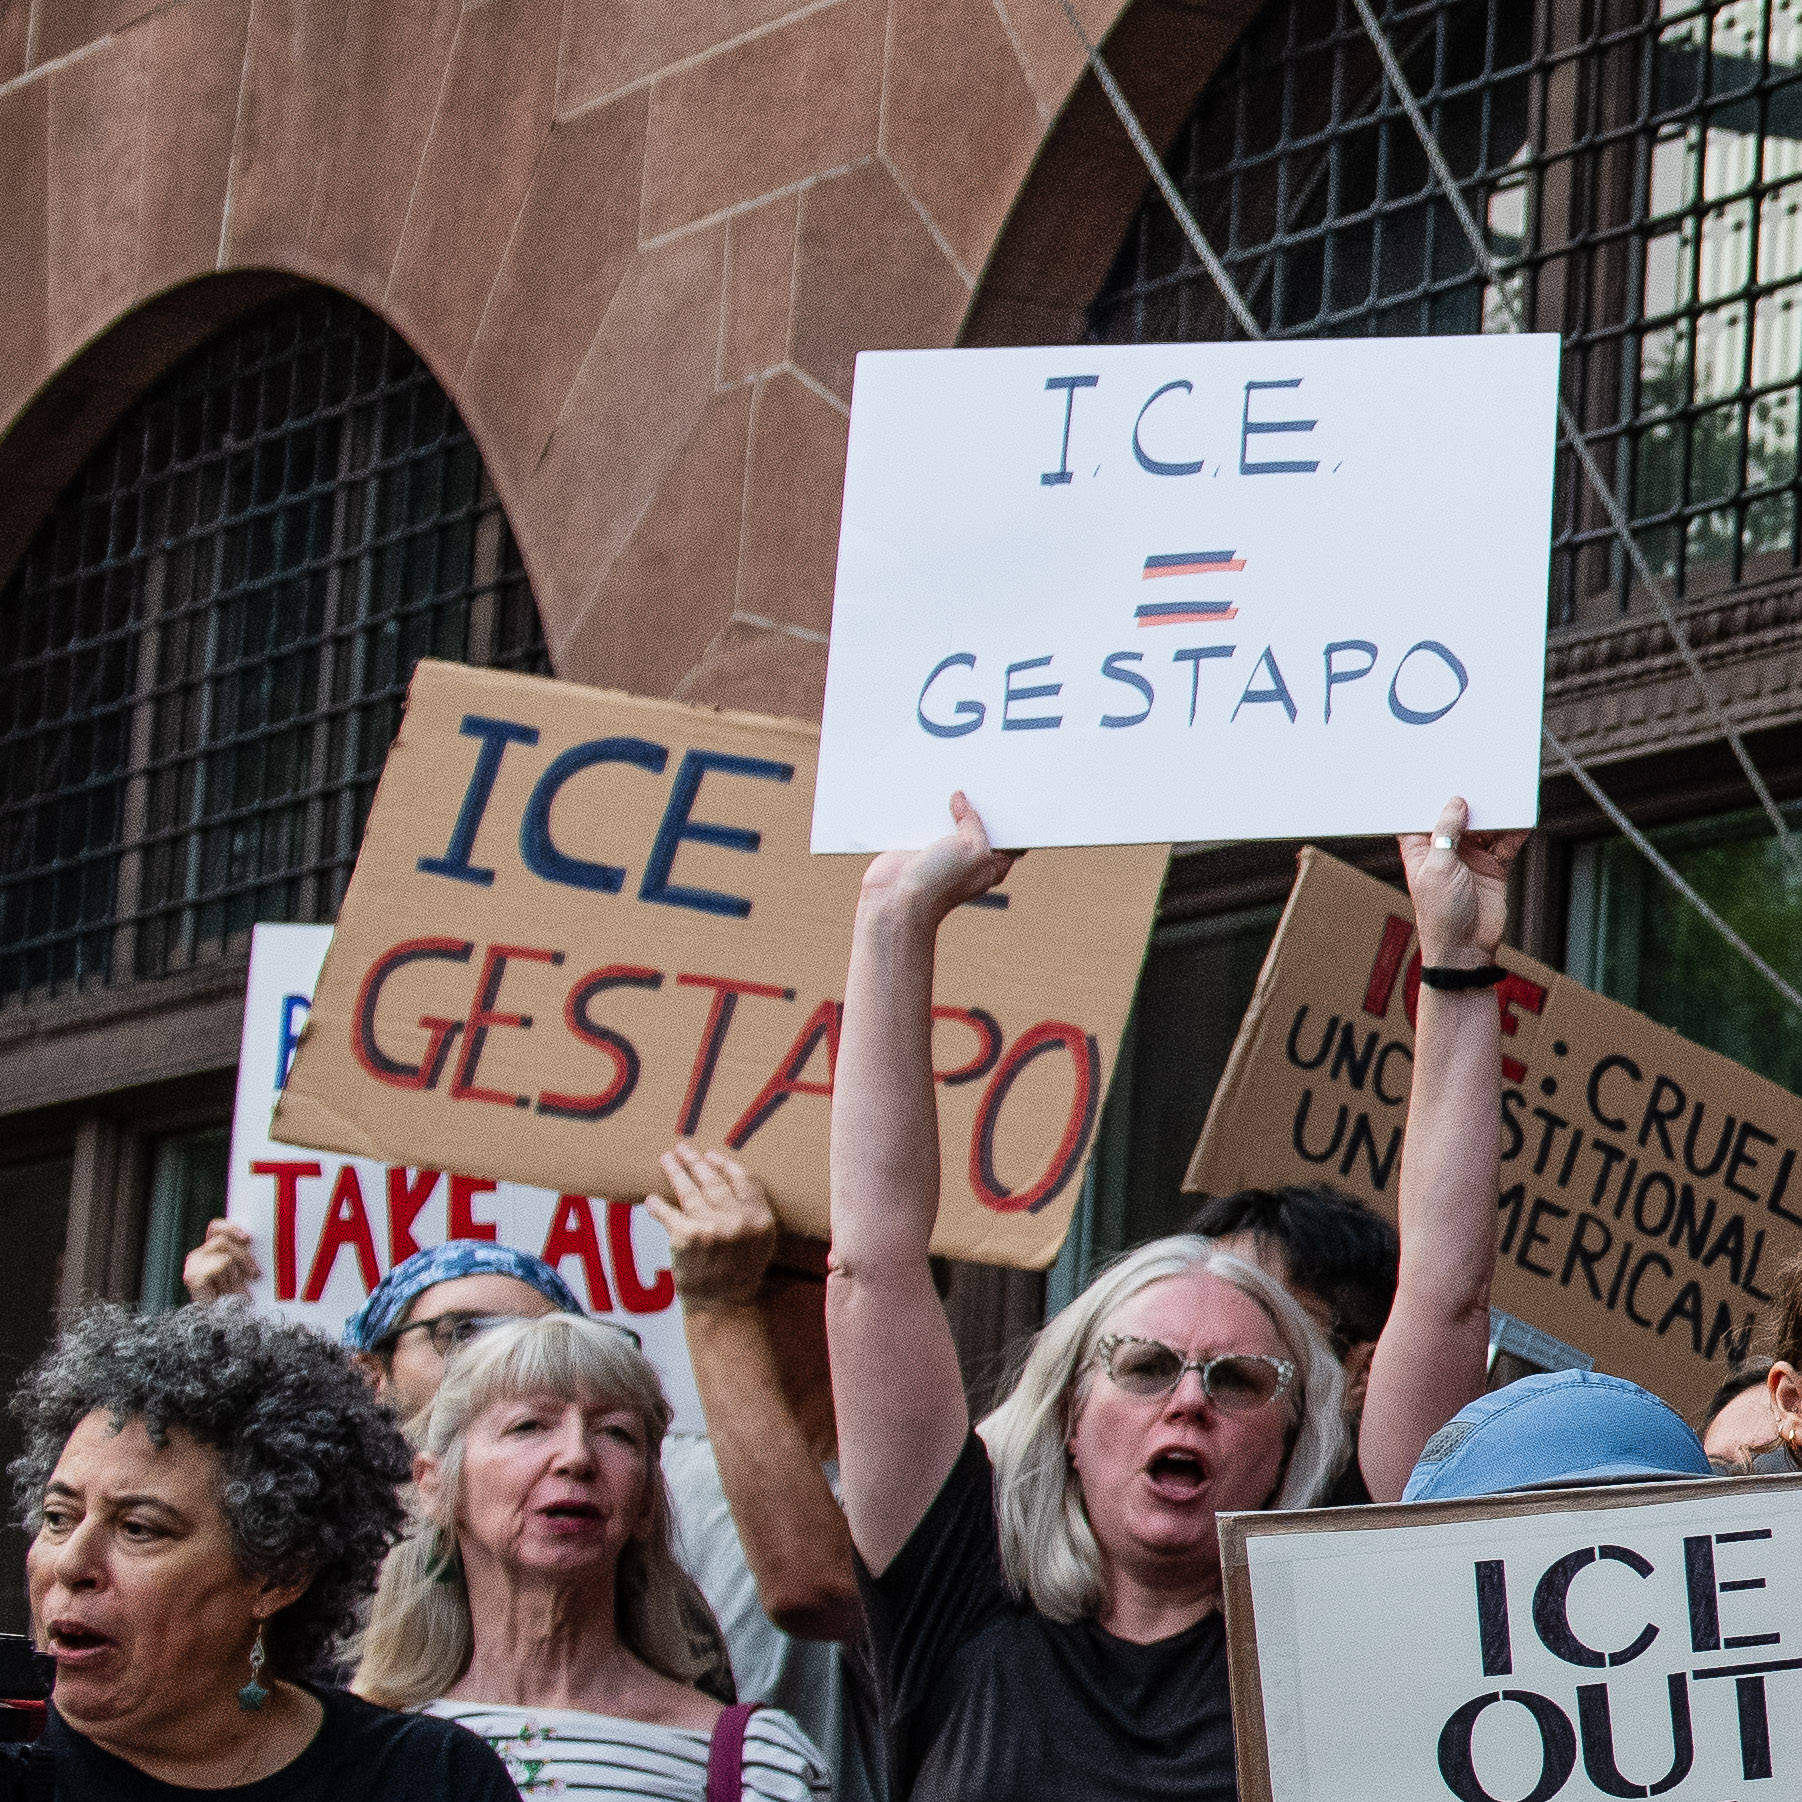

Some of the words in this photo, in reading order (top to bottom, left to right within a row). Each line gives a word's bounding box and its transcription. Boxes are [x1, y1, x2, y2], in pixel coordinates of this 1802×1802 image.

[1039, 374, 1343, 487] I.C.E.
[916, 638, 1470, 740] GESTAPO
[415, 713, 796, 919] ICE
[347, 935, 1105, 1214] GESTAPO
[1362, 914, 1569, 1097] IE:
[1286, 1004, 1774, 1303] UNCSTITIONAL
[249, 1160, 497, 1302] TAKE
[540, 1193, 677, 1315] AC
[1473, 1528, 1782, 1678] ICE
